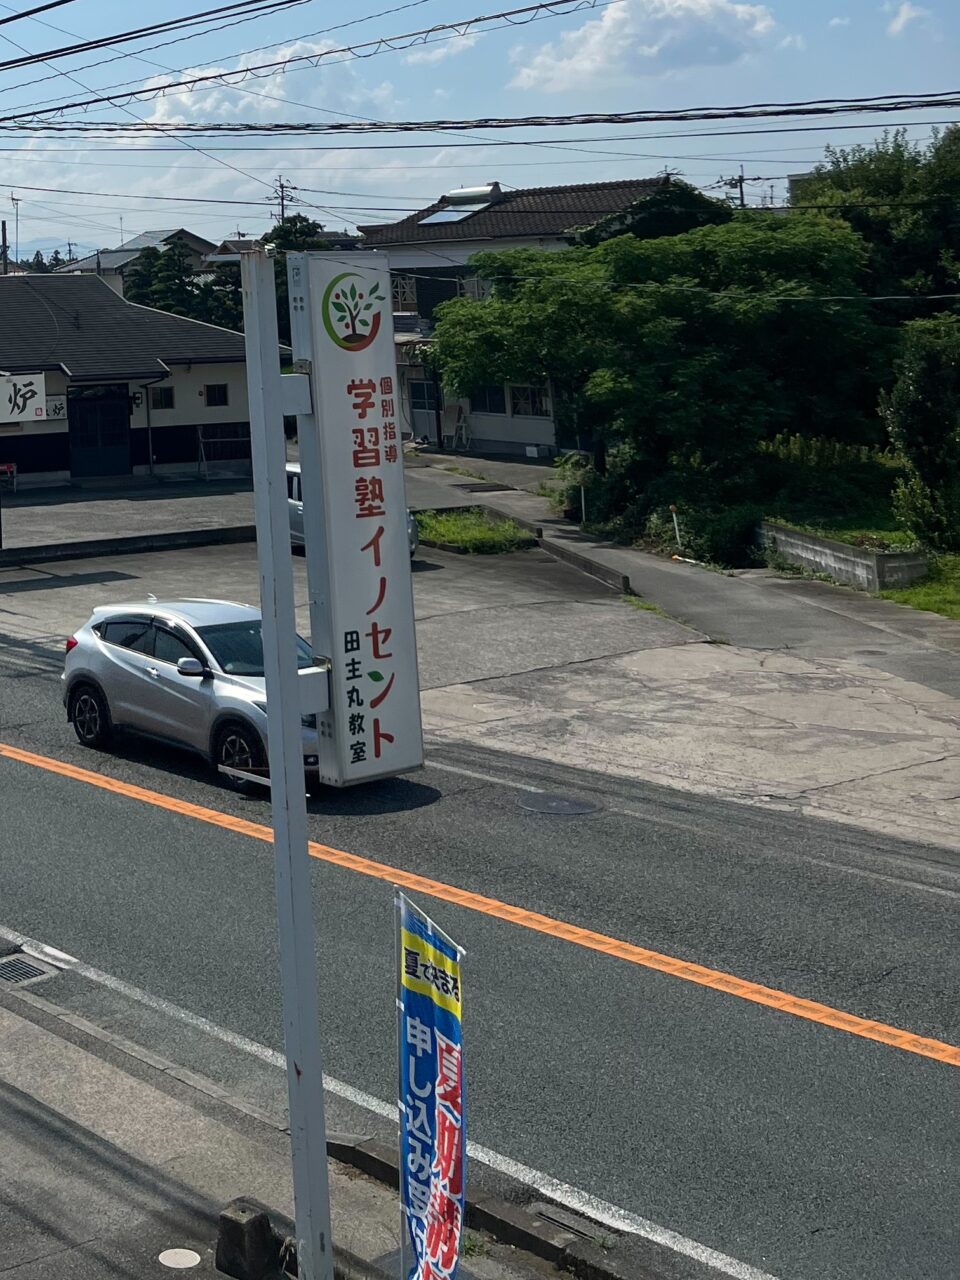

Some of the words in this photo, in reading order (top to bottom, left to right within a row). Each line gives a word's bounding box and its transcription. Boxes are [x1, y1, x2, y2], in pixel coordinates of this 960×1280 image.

[379, 376, 398, 463] 個別指導
[344, 630, 367, 764] 田主丸教室
[422, 1027, 461, 1280] 夏期講
